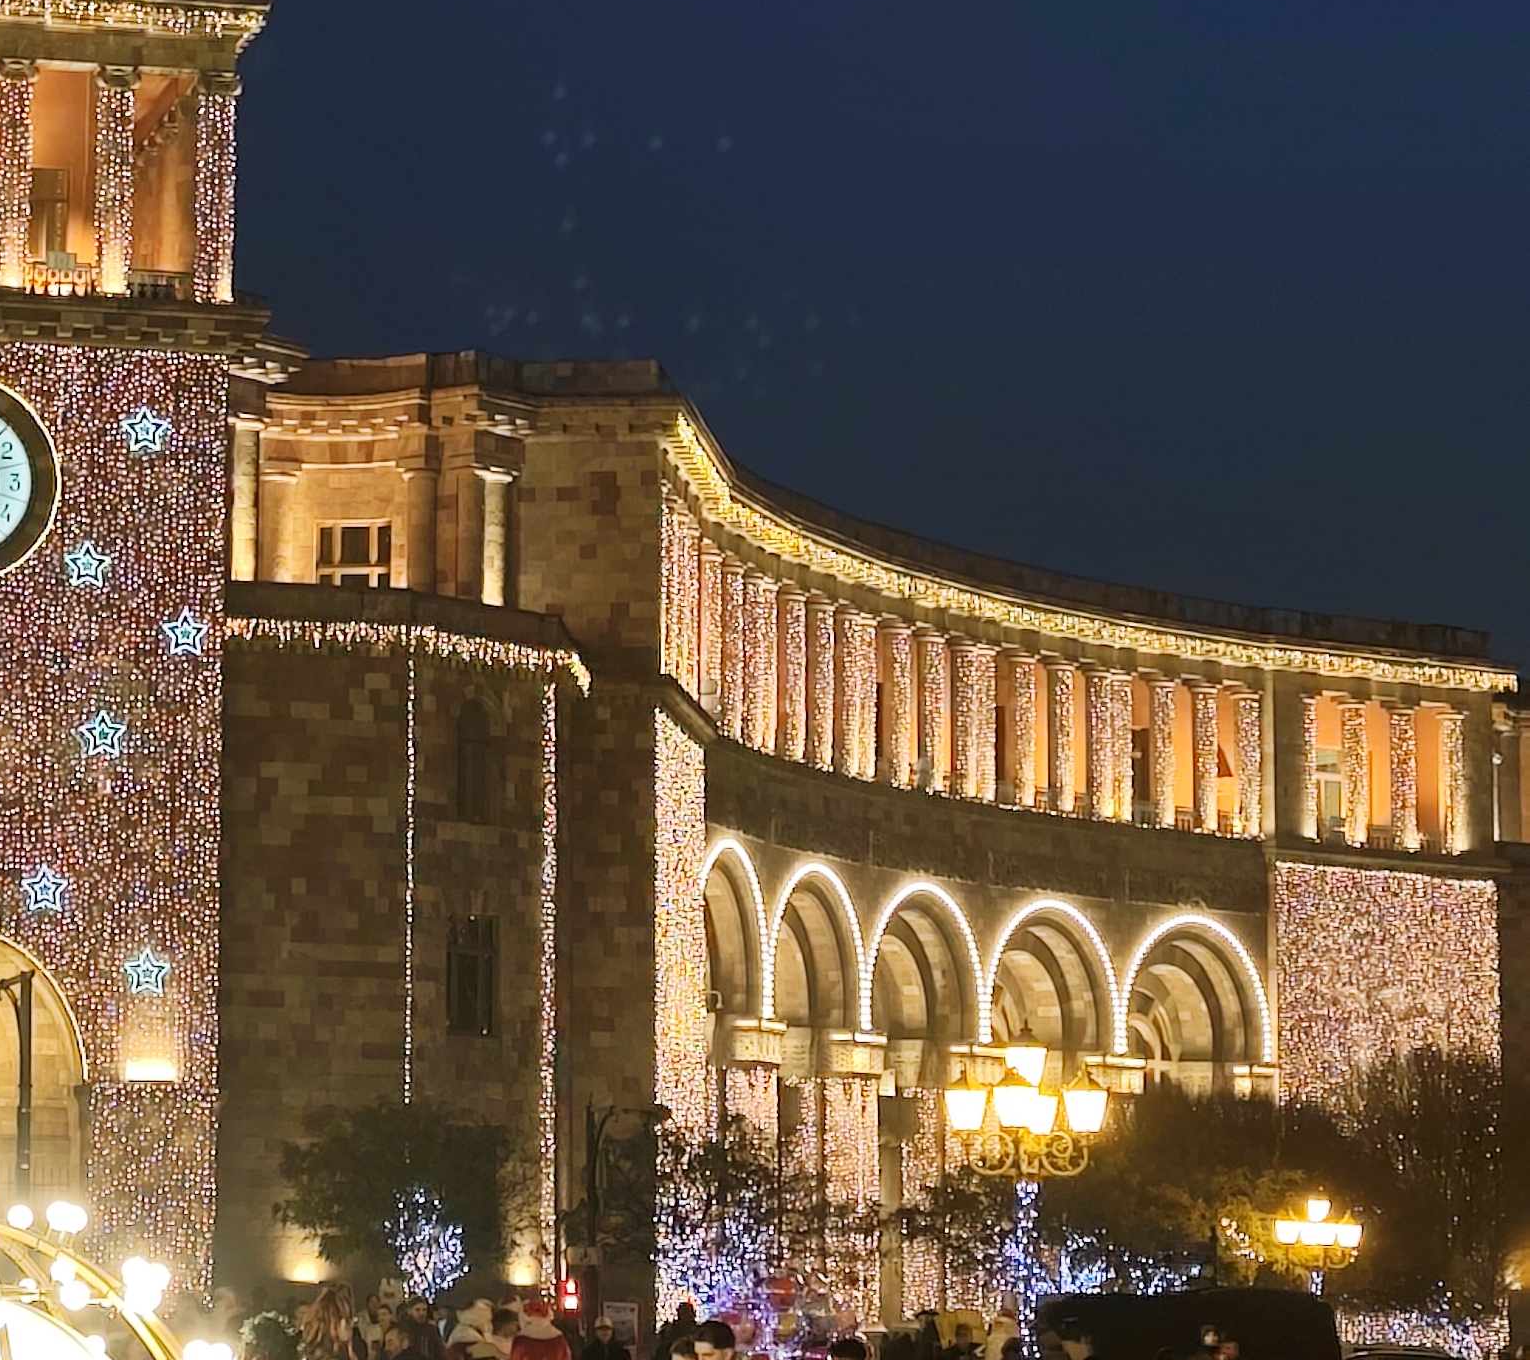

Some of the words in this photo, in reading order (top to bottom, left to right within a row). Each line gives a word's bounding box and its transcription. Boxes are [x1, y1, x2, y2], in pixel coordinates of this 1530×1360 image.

[1, 442, 13, 459] 2
[9, 473, 20, 491] 3
[0, 503, 10, 522] 4
